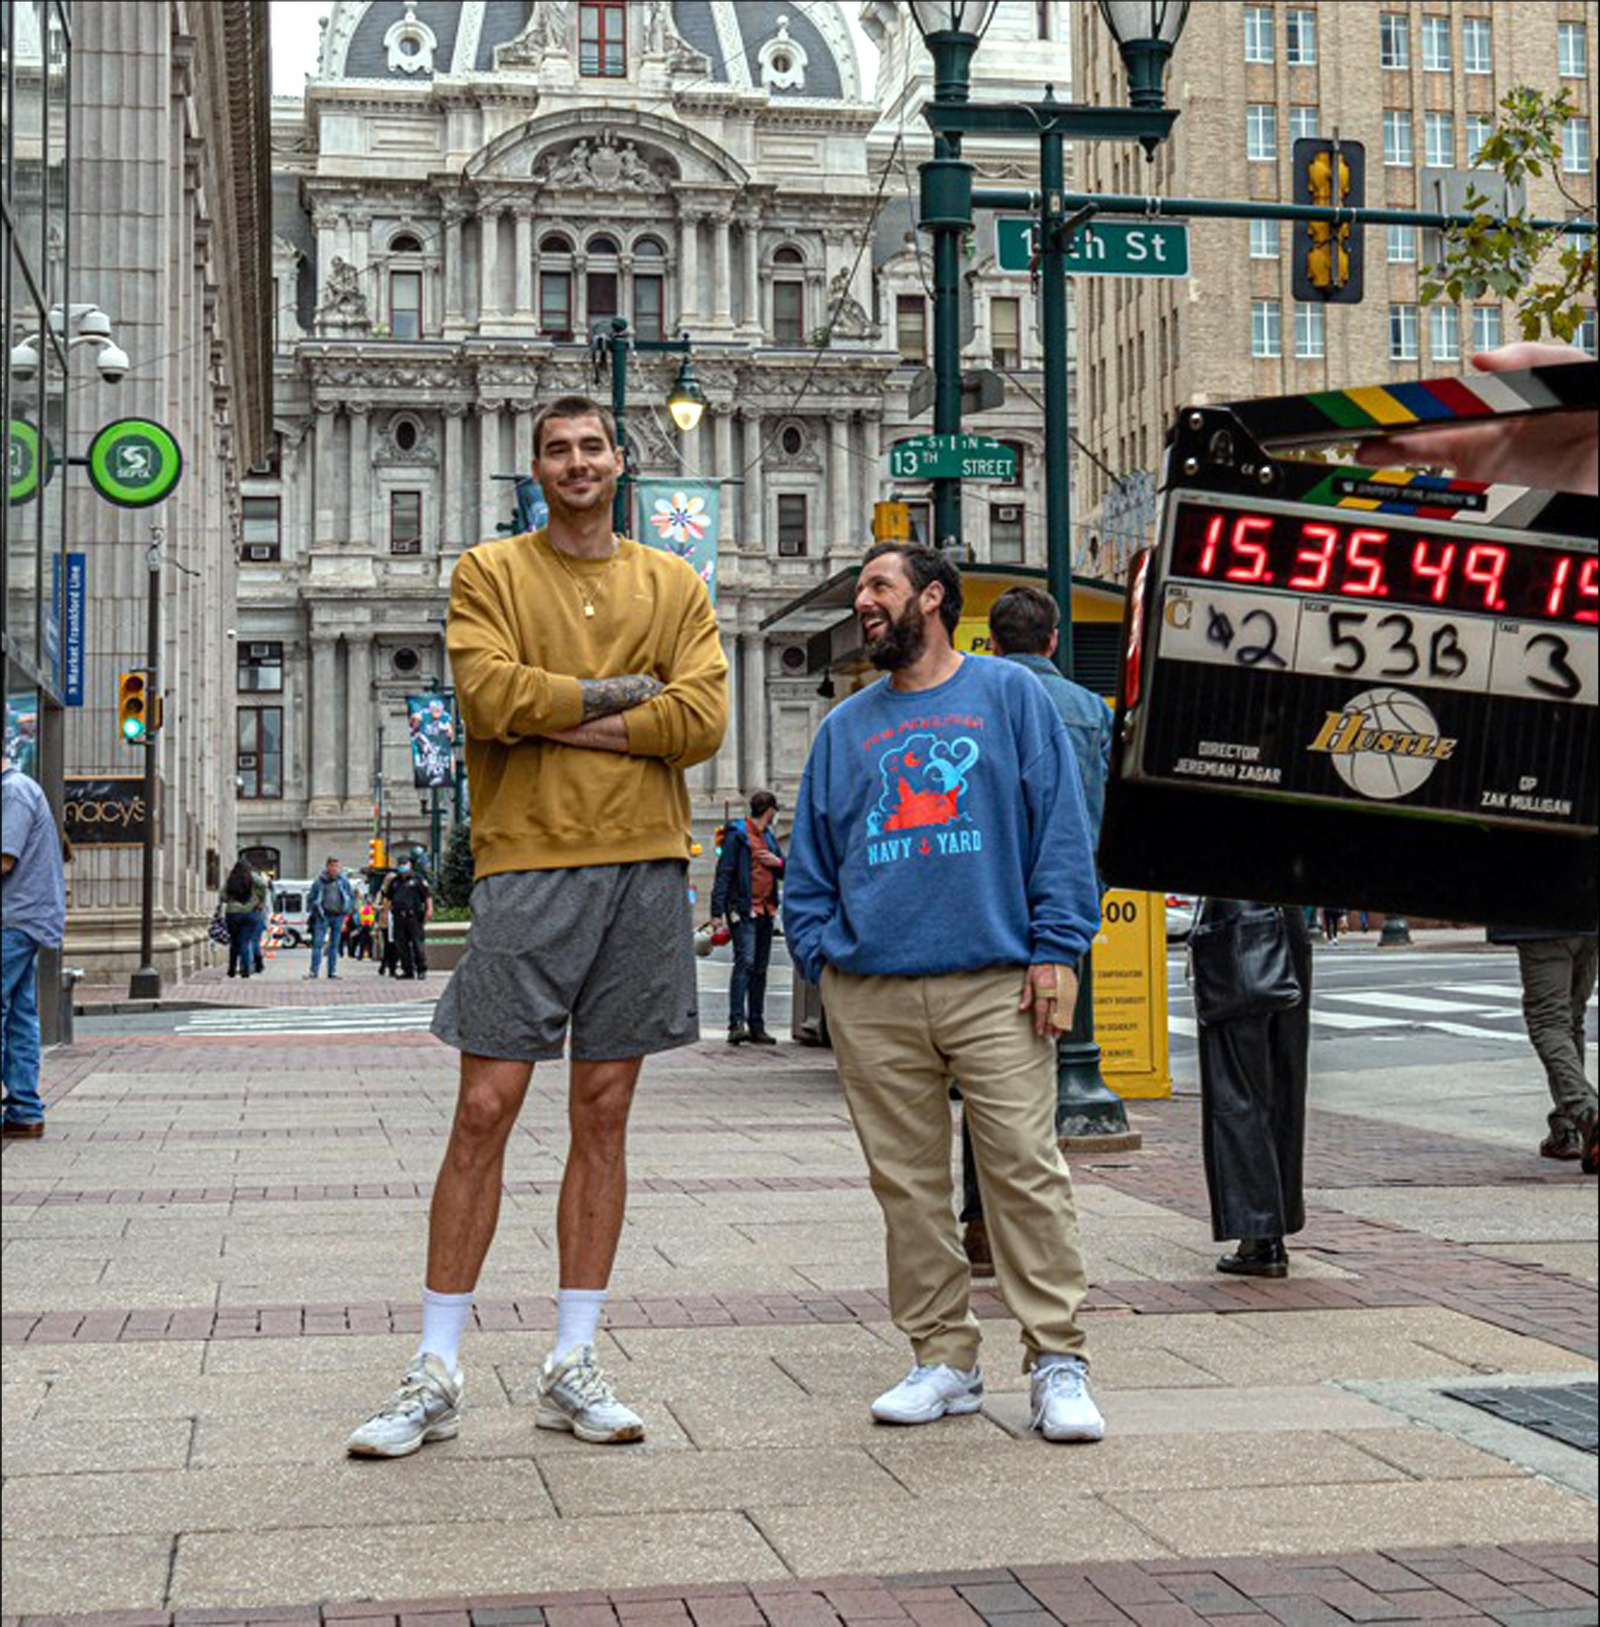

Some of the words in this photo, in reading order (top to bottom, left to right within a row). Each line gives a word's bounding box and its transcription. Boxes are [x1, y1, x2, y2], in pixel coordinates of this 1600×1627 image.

[1126, 231, 1166, 261] St
[962, 460, 1012, 475] STREET
[1165, 600, 1193, 630] C
[1329, 612, 1468, 679] 53B
[1524, 633, 1582, 699] 3
[1306, 711, 1458, 760] HUSTLE
[1198, 741, 1260, 761] DIRECTOR
[1173, 758, 1236, 778] JEREMIAH
[1237, 764, 1282, 783] ZAGAR
[1481, 790, 1507, 808] ZAK
[1509, 794, 1572, 816] MULLIGAN
[867, 837, 912, 866] NAVY
[936, 829, 982, 854] YARD
[1101, 901, 1136, 923] 00
